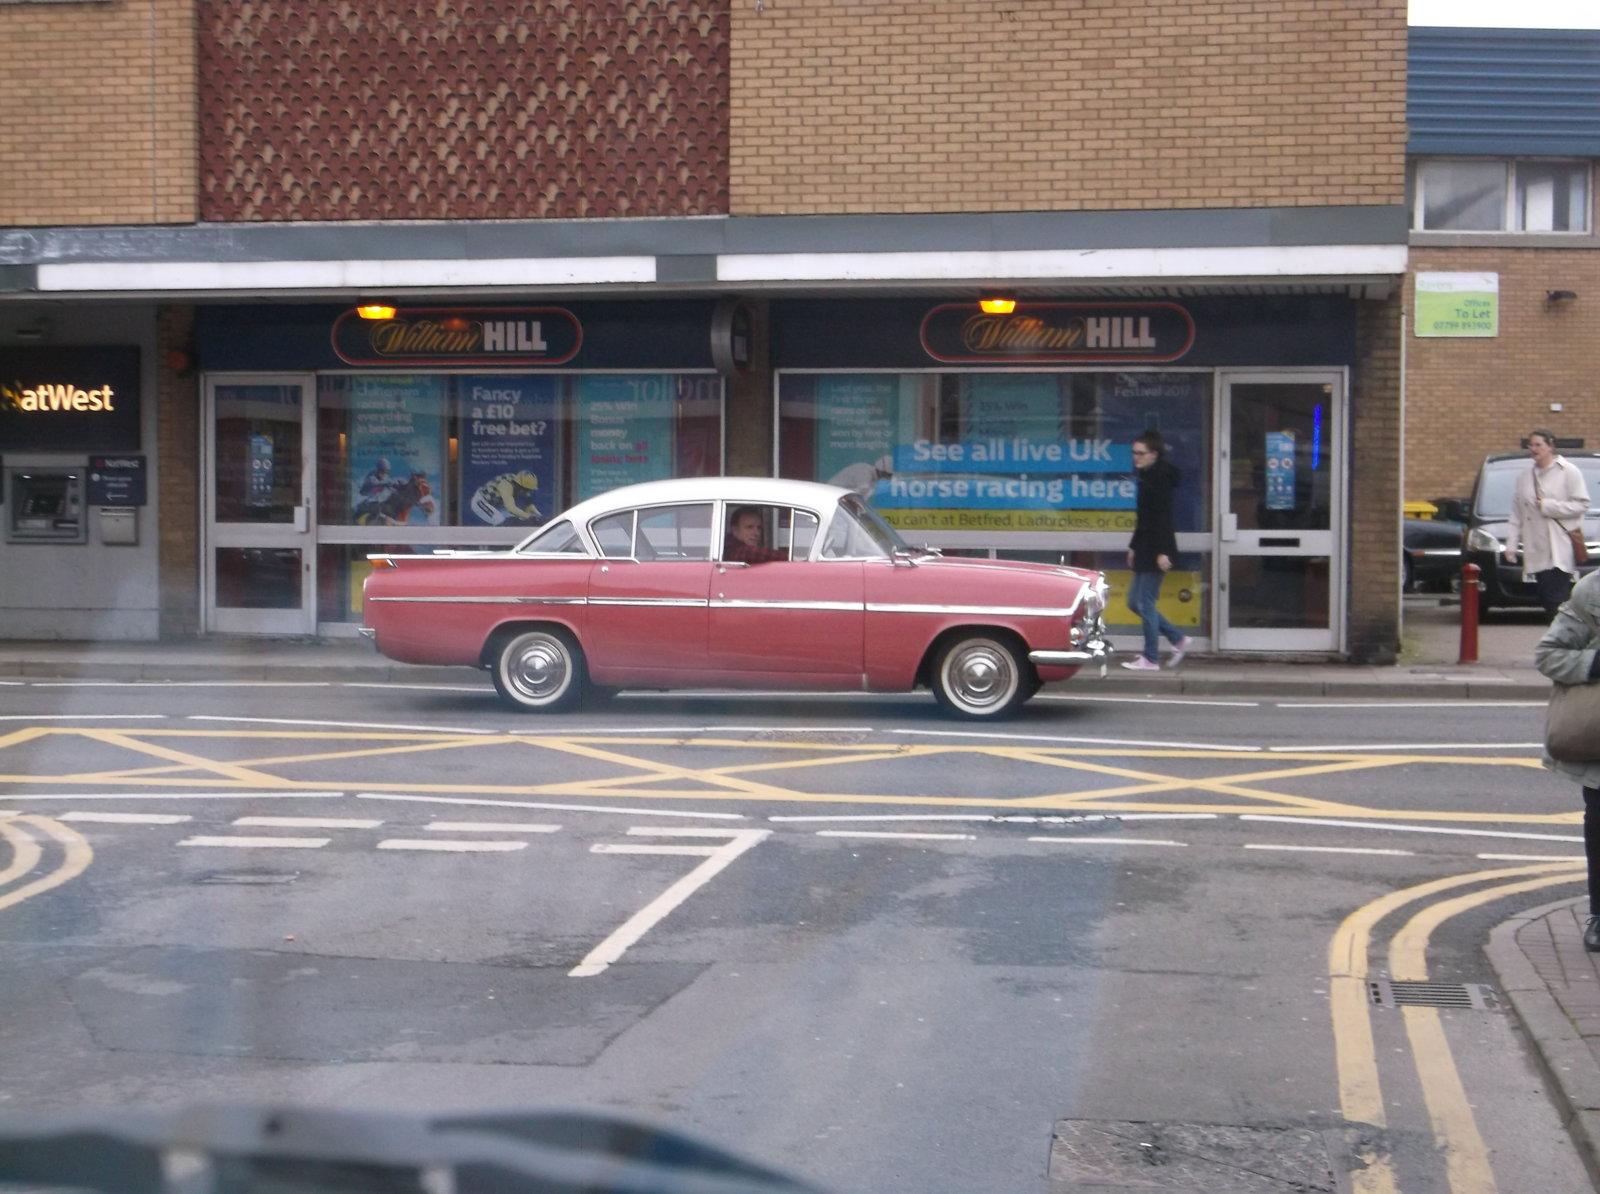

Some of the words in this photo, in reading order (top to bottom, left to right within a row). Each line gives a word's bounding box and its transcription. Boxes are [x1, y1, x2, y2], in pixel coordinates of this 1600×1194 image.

[1455, 308, 1469, 319] To
[1472, 309, 1491, 319] Let
[370, 319, 481, 353] William
[484, 321, 547, 351] HILL
[966, 315, 1083, 349] William
[1086, 317, 1156, 348] HILL
[472, 386, 522, 404] Fancy
[1114, 385, 1162, 397] Festival
[1164, 385, 1191, 397] 2017
[472, 407, 483, 419] a
[486, 404, 515, 419] £10
[472, 421, 506, 436] free
[509, 420, 547, 436] bet?
[590, 429, 628, 439] money
[591, 440, 617, 450] back
[619, 442, 633, 450] on
[913, 439, 964, 462] See
[971, 438, 1004, 462] all
[1013, 438, 1062, 462] live
[1069, 439, 1112, 462] UK
[890, 475, 969, 498] horse
[976, 474, 1064, 503] racing
[1071, 474, 1137, 498] here
[903, 514, 938, 526] can't
[941, 514, 955, 526] at
[959, 513, 1014, 527] Betfred,
[1018, 513, 1091, 529] Ladbrokes,
[1096, 517, 1111, 528] or
